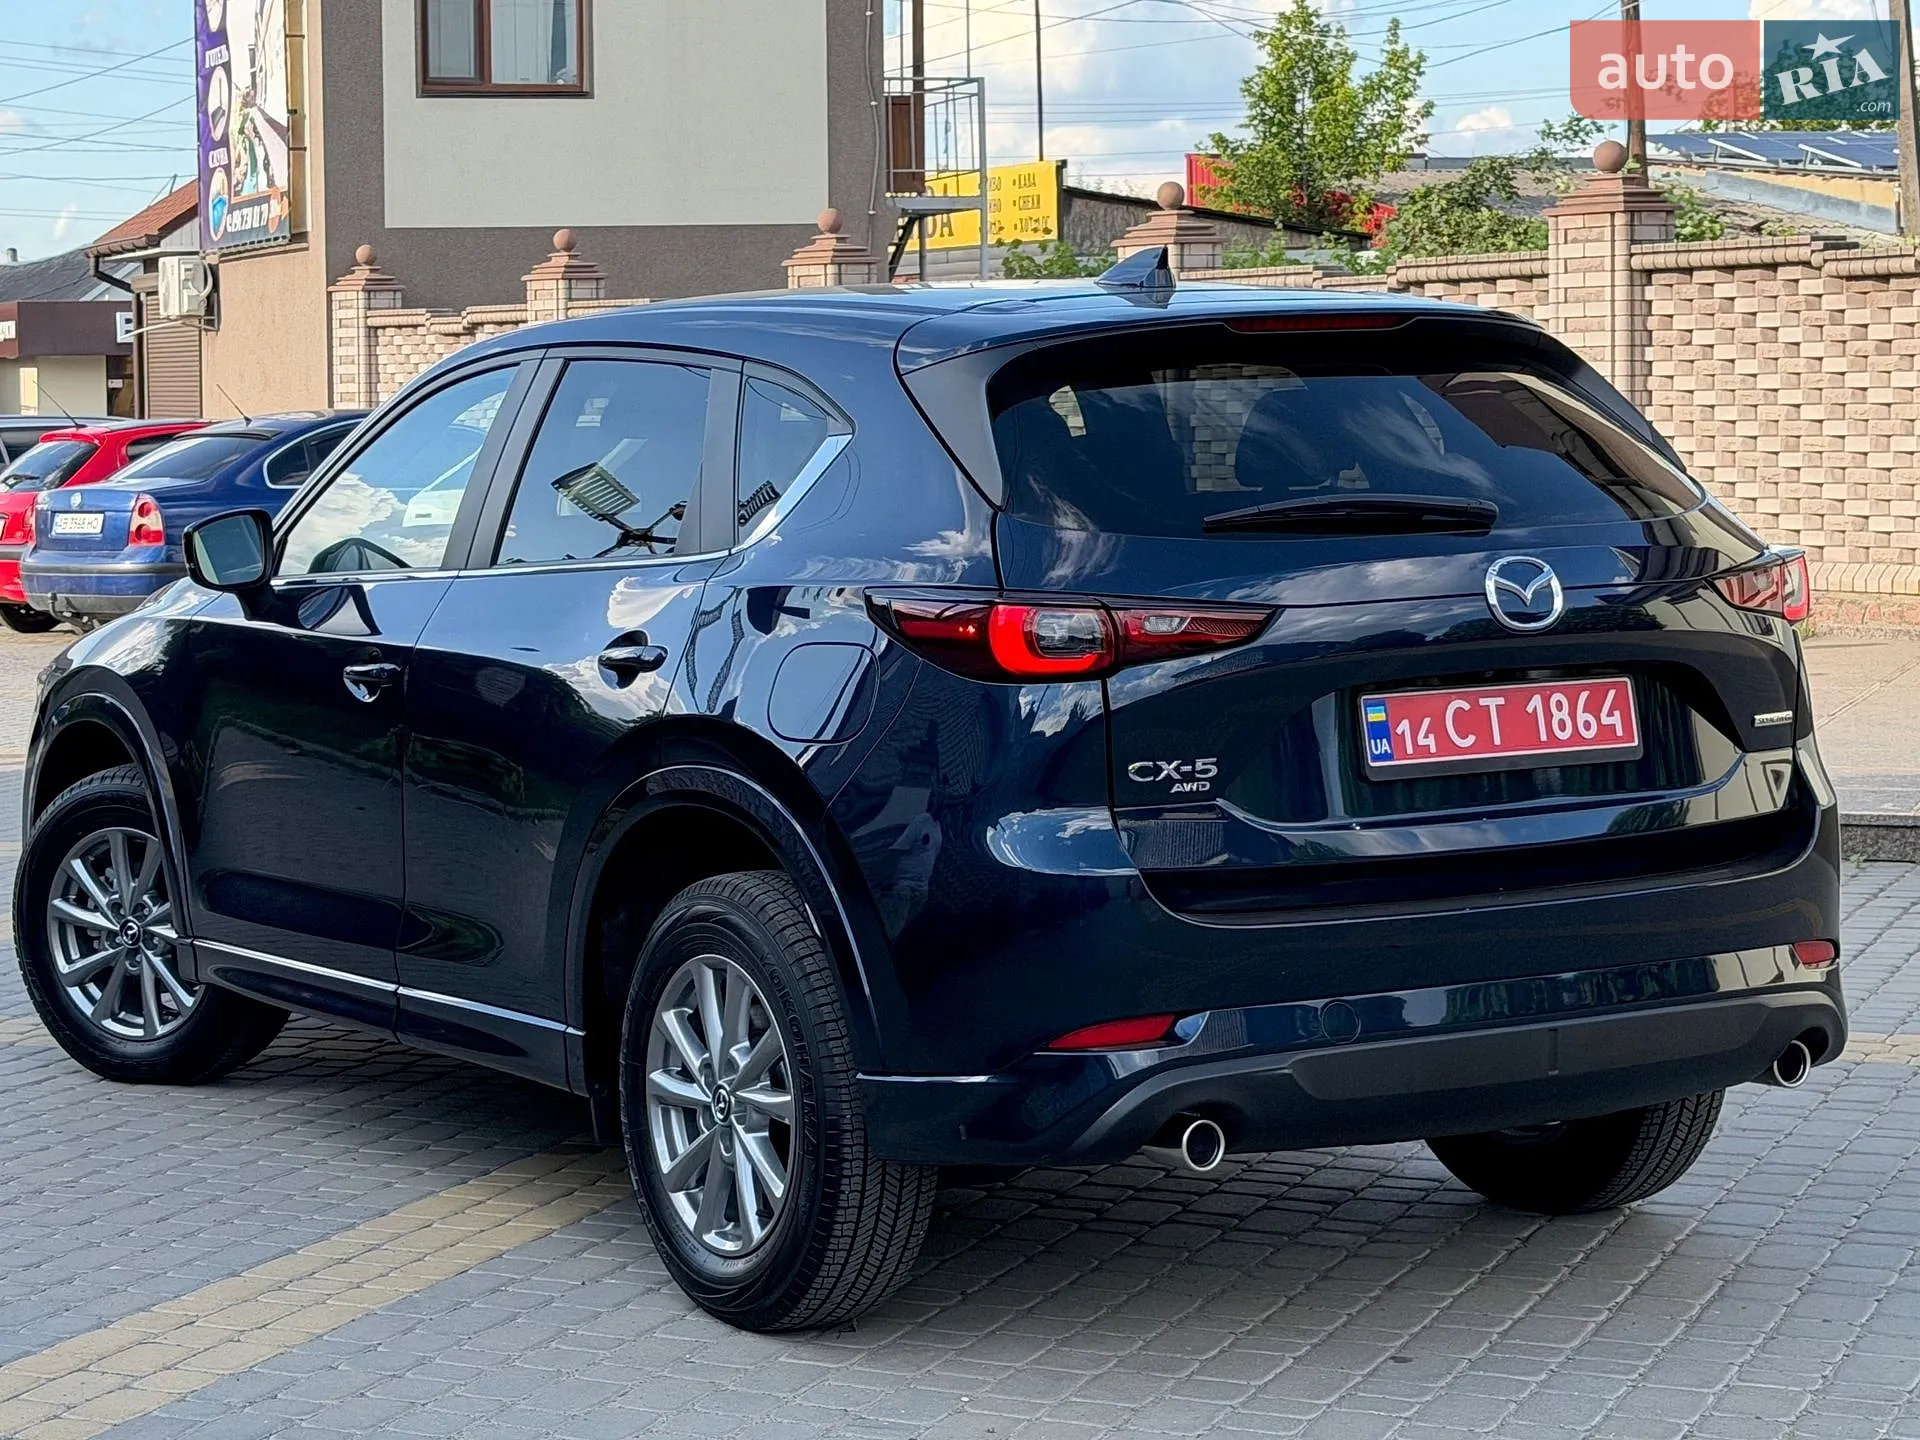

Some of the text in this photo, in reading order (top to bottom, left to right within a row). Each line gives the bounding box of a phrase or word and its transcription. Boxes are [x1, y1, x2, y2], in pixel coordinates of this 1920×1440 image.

[1394, 689, 1624, 755] 14 CT 1864
[1370, 737, 1391, 755] UA
[1128, 757, 1218, 782] CX-5
[1169, 781, 1211, 793] AWD
